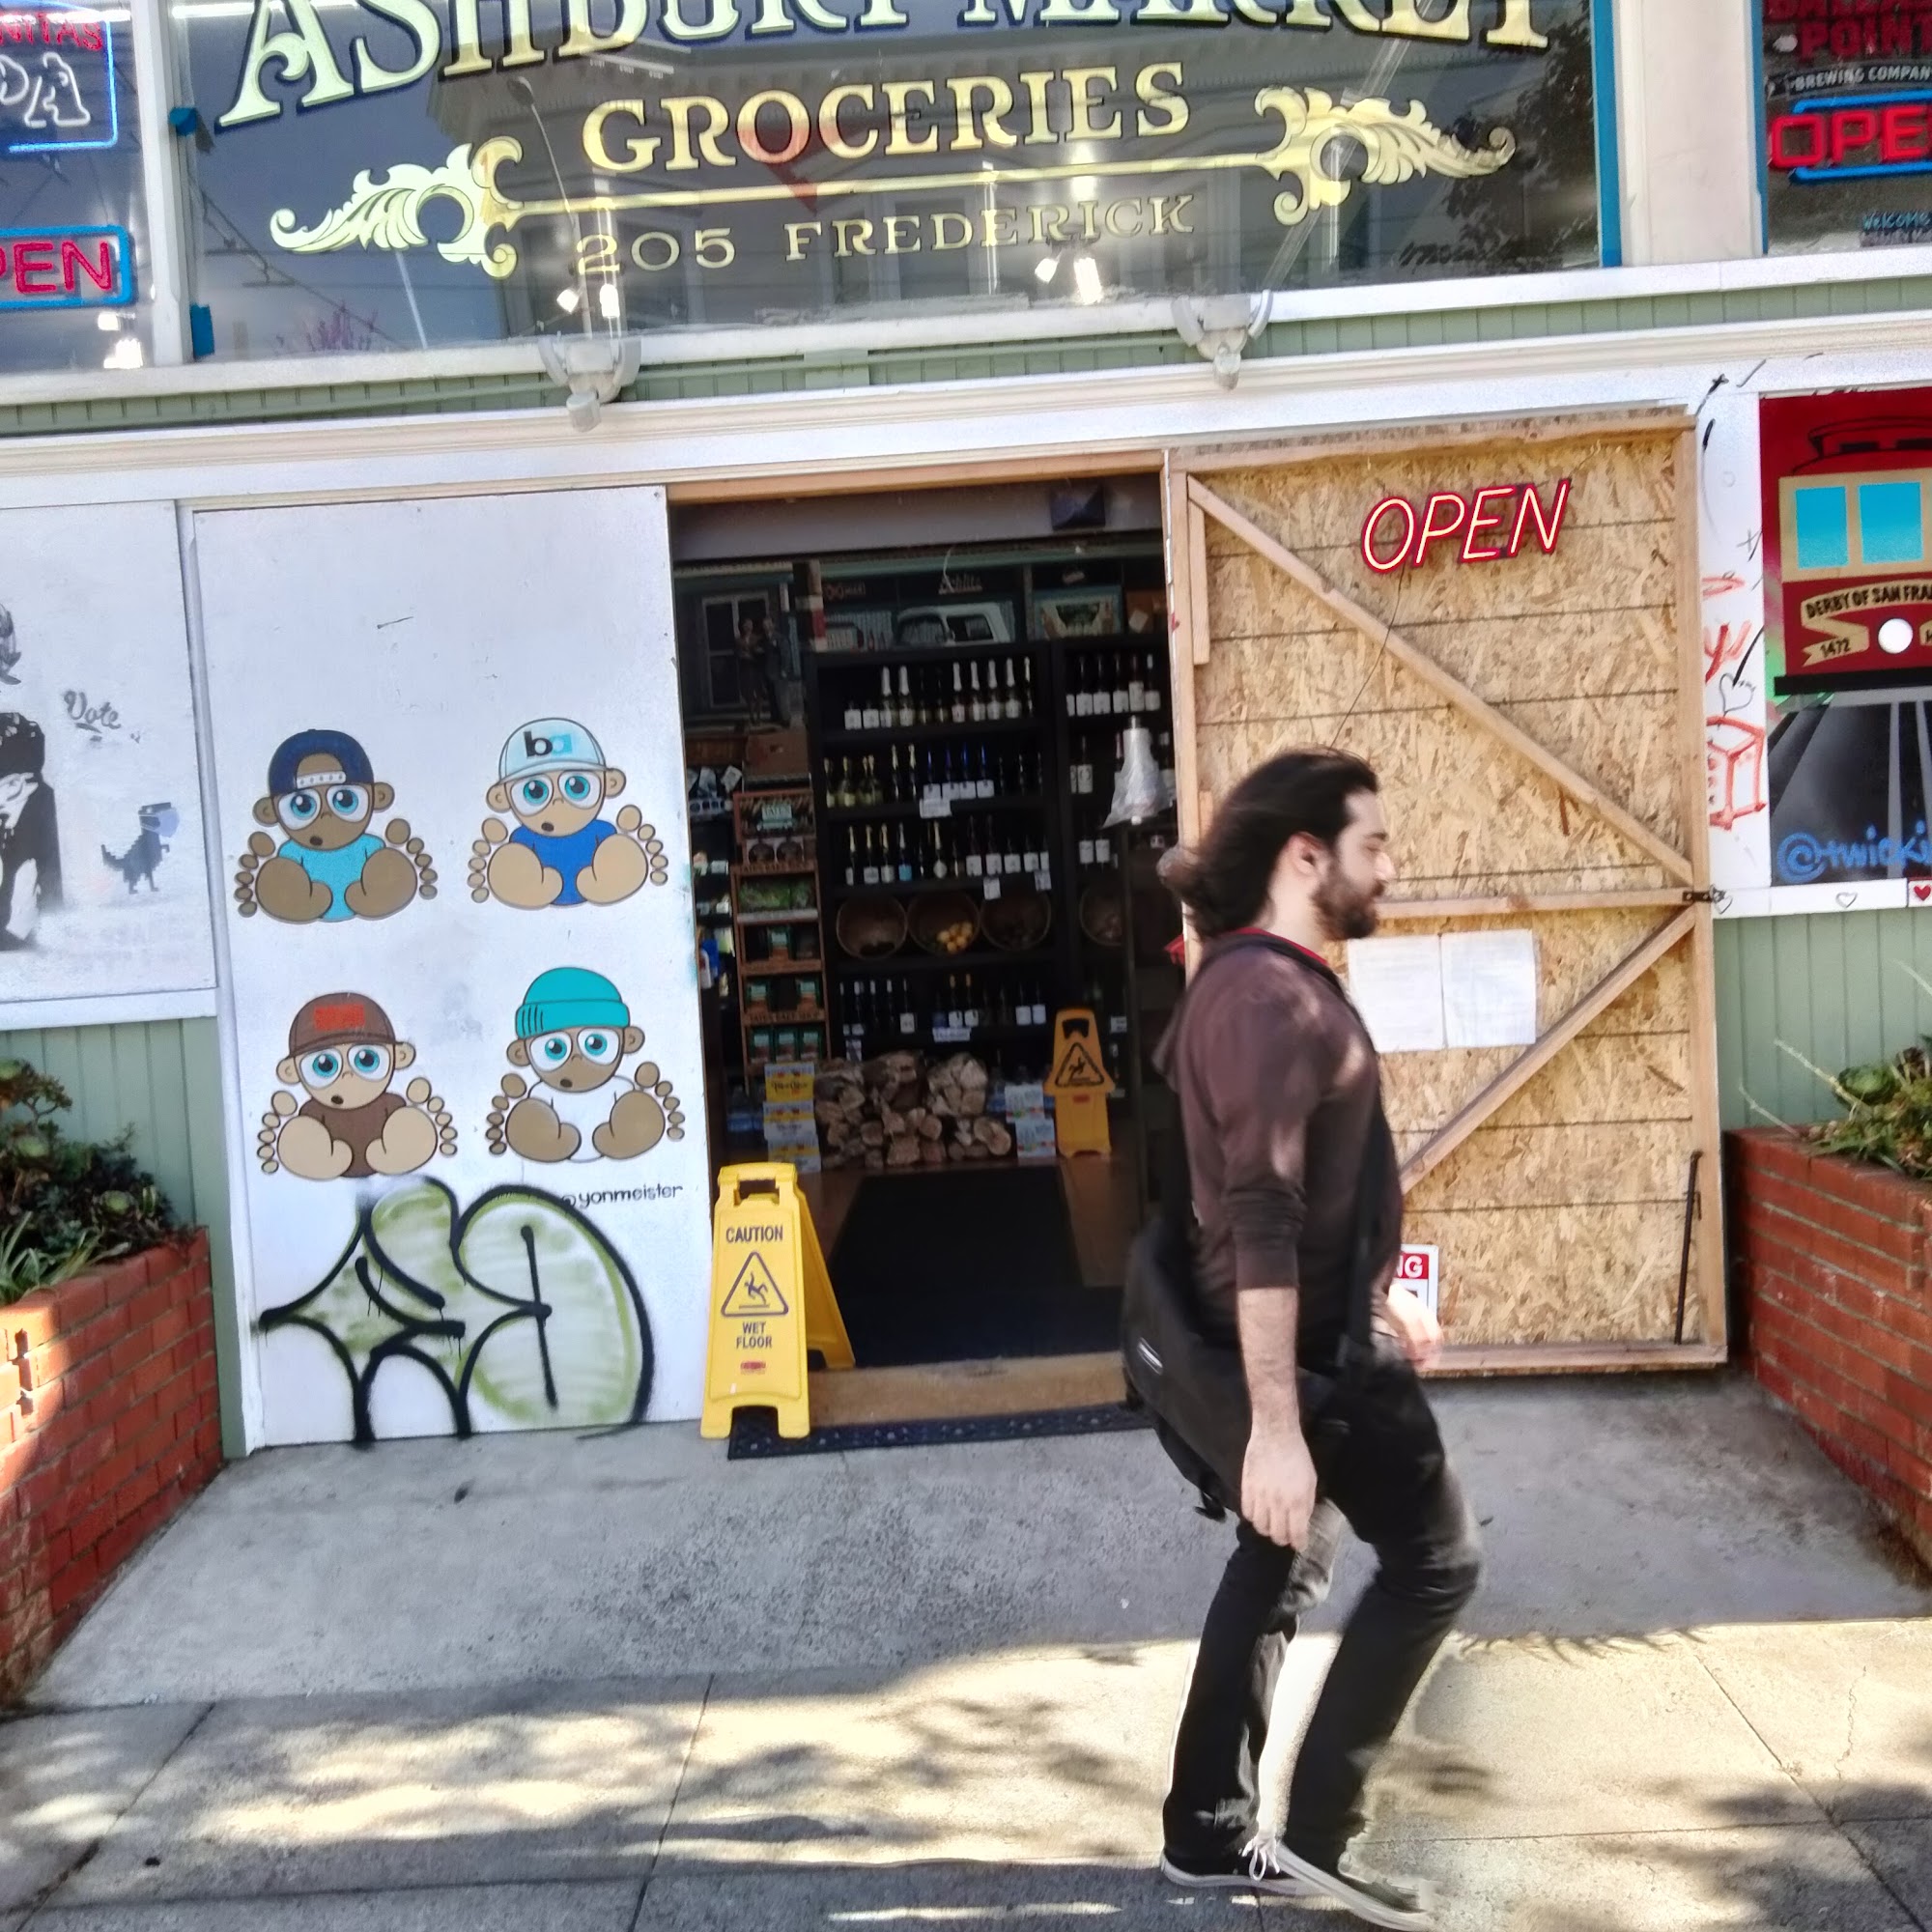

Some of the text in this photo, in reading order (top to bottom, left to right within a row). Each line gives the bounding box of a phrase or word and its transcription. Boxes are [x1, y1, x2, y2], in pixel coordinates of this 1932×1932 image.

[1794, 68, 1864, 91] BREWING
[582, 62, 1189, 173] GROCERIES
[1771, 105, 1932, 168] OPE
[576, 195, 1195, 276] 205 FREDERICK
[0, 240, 112, 294] EN
[1360, 476, 1573, 575] OPEN
[1804, 583, 1932, 619] DERBY OF SAN FRA
[63, 690, 121, 729] Vote
[725, 1225, 783, 1244] CAUTION
[735, 1336, 773, 1350] FLOOR
[742, 1321, 766, 1335] WET
